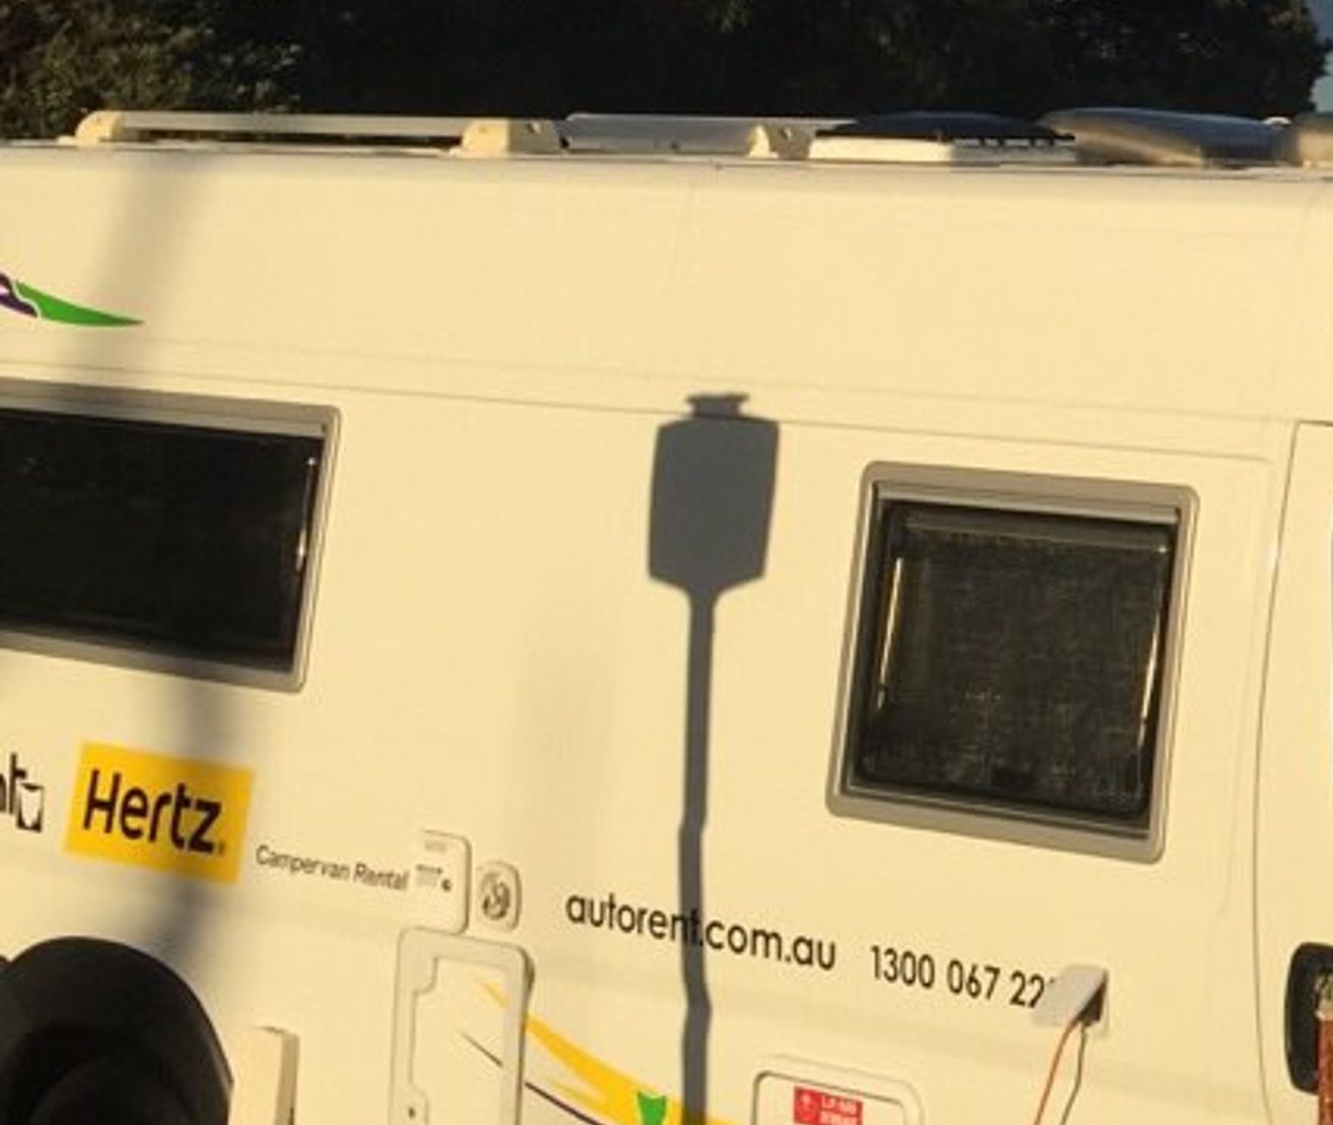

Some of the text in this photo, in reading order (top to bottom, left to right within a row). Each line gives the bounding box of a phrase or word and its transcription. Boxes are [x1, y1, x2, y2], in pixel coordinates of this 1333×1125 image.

[84, 768, 222, 854] Hertz
[255, 844, 350, 880] Campervan
[353, 861, 409, 892] Rental
[565, 892, 1056, 1009] autorent.com.au 1300 067 22
